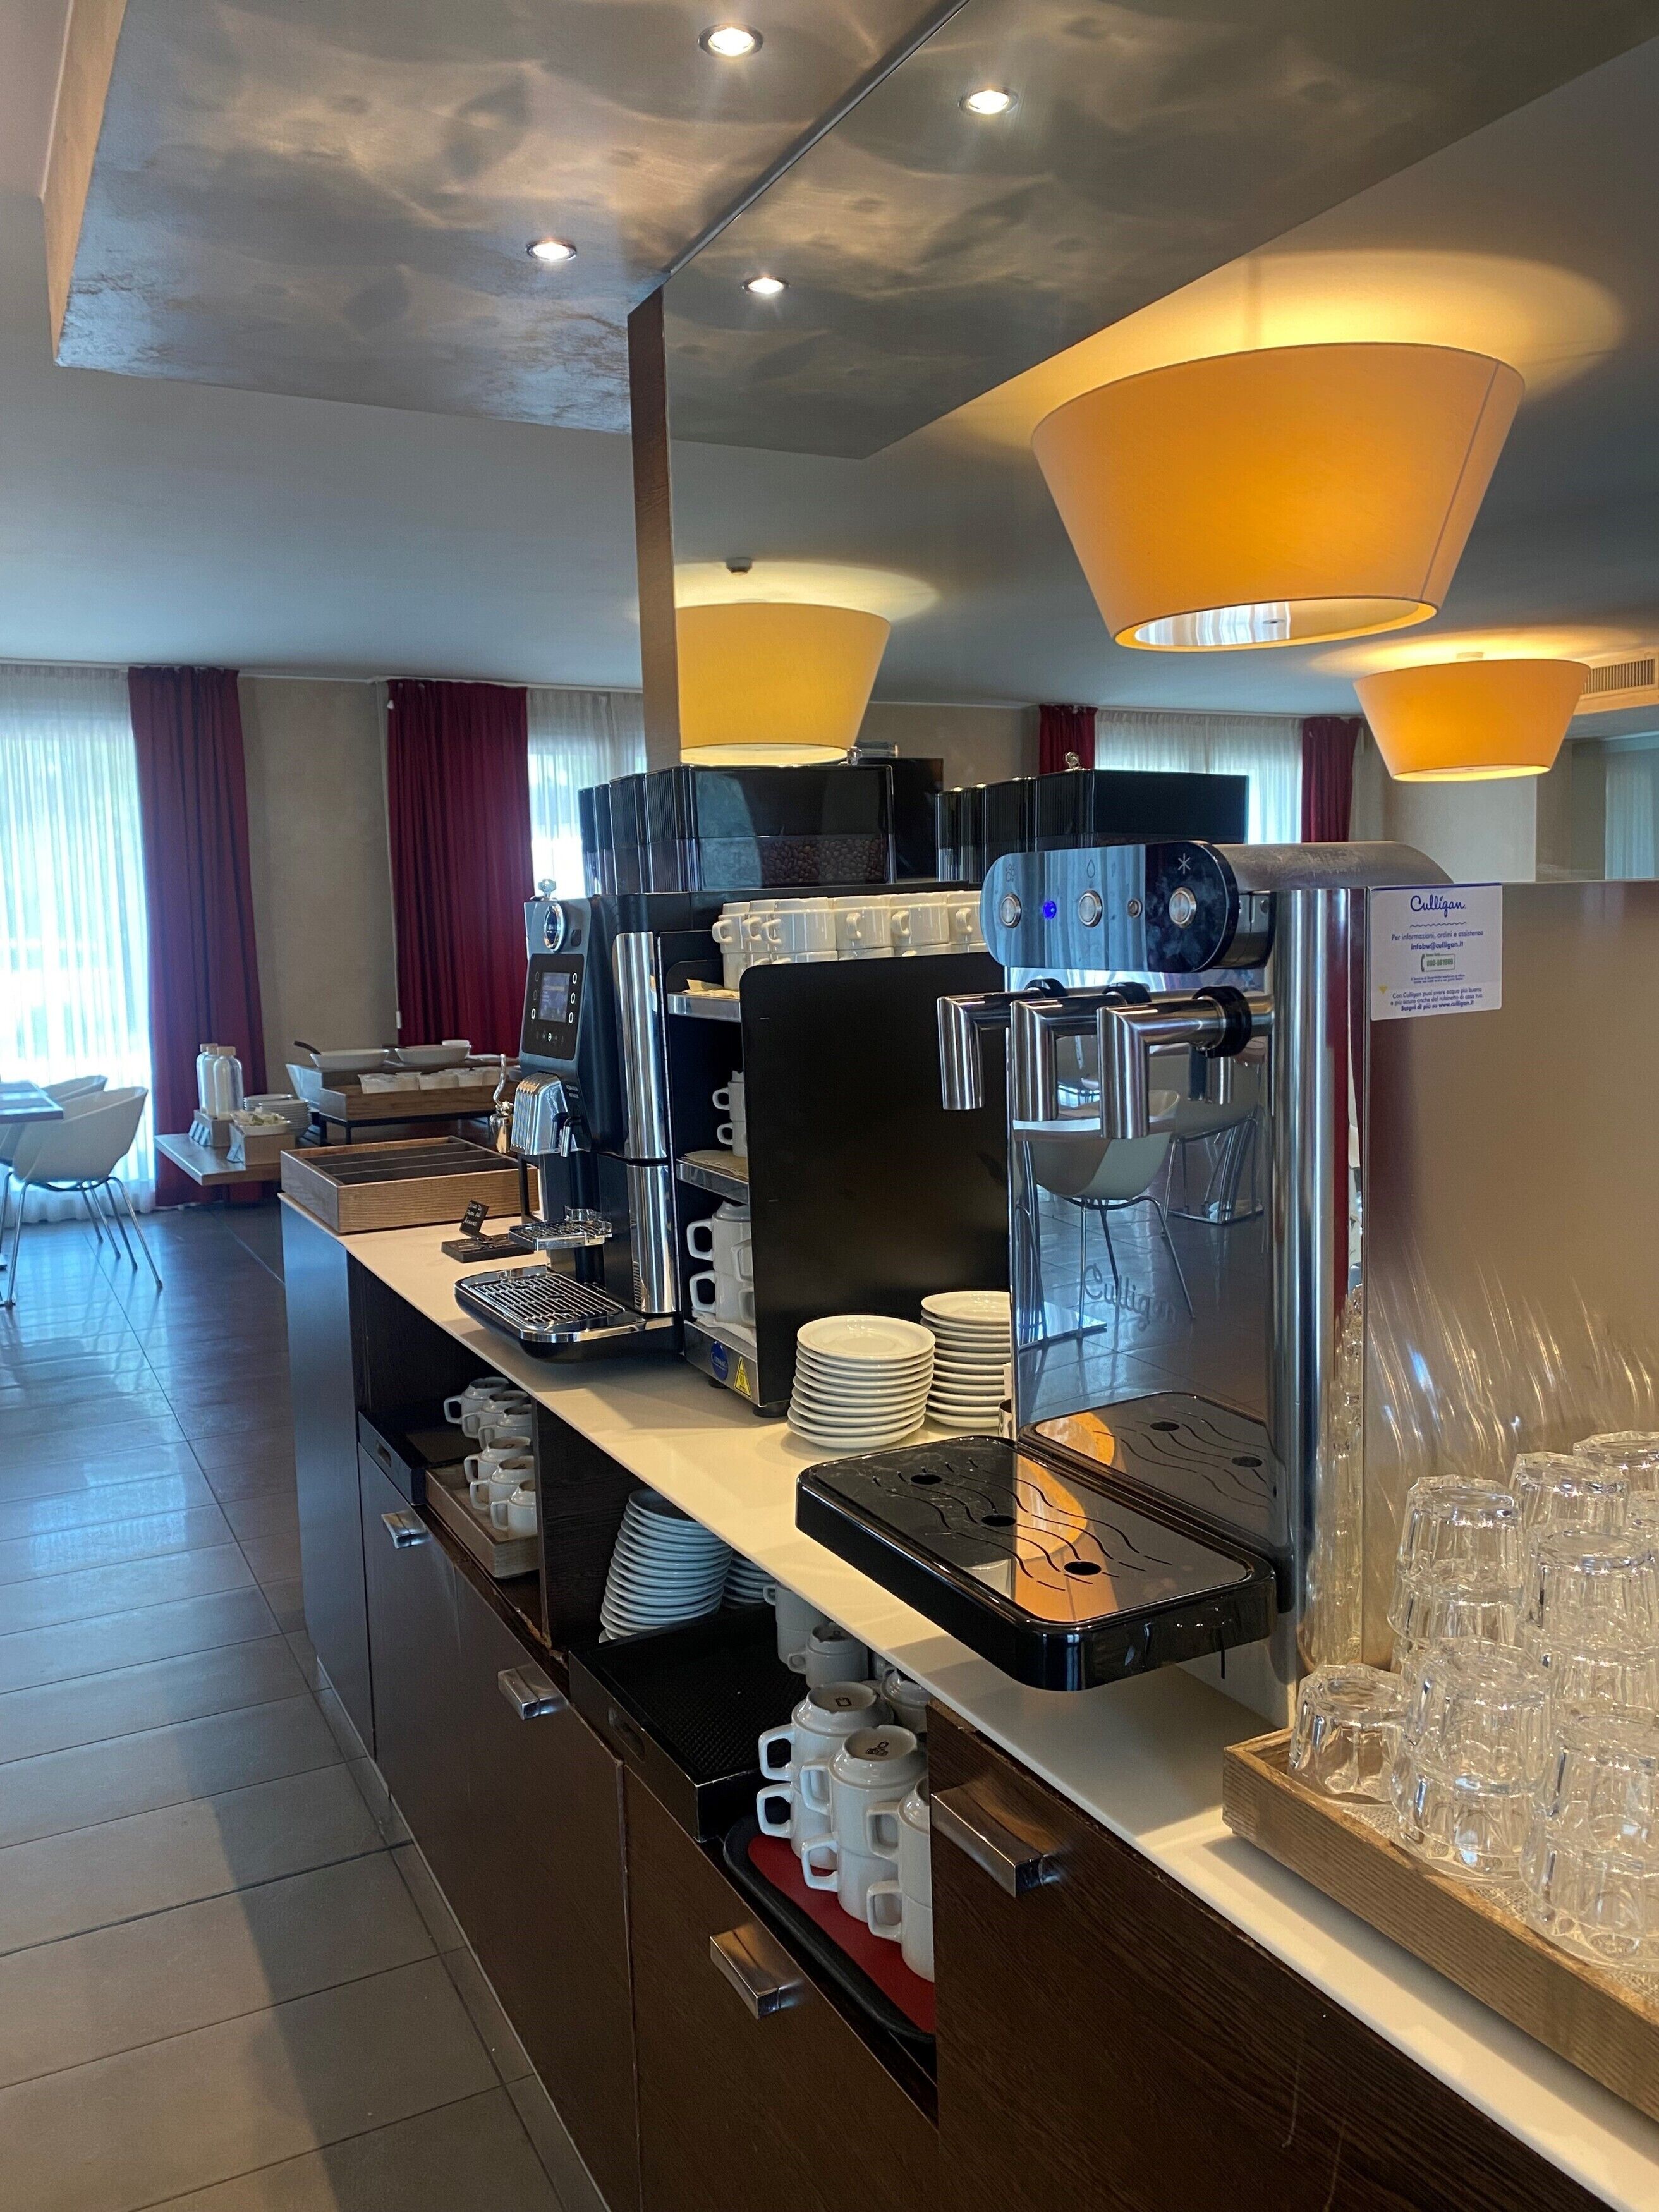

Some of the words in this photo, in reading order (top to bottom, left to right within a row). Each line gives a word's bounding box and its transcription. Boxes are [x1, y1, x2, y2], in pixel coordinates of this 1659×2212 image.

[1410, 894, 1465, 917] Culligan
[1411, 940, 1464, 950] infobw@culligan.it
[1083, 1263, 1176, 1332] Culligan
